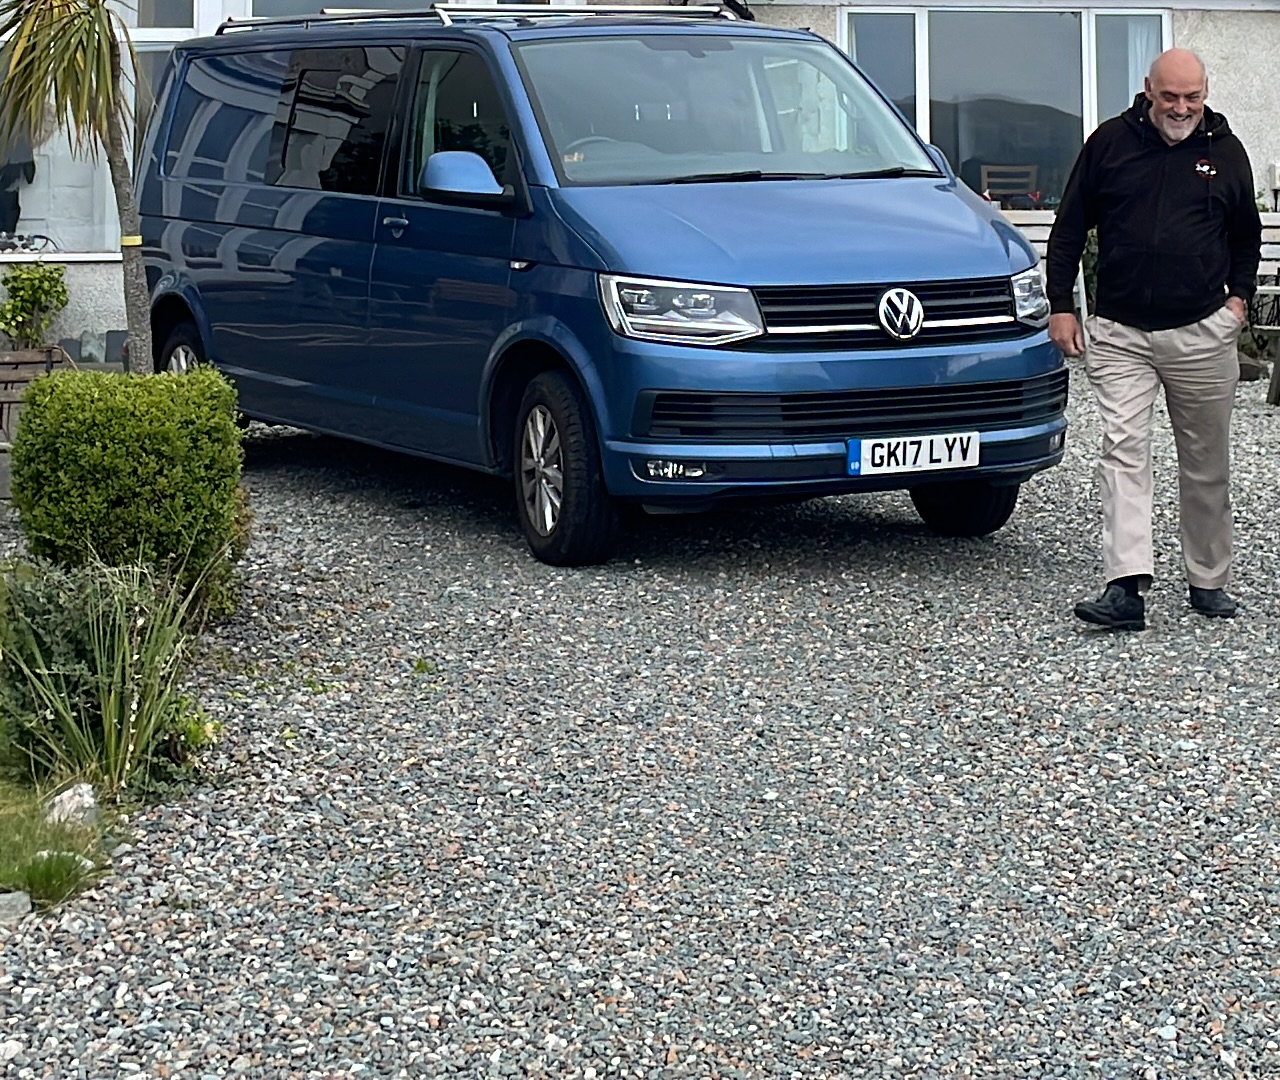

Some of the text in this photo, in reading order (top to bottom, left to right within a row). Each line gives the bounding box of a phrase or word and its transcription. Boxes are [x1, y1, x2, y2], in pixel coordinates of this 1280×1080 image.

[879, 288, 923, 338] VW
[871, 436, 971, 468] GK17 LYV
